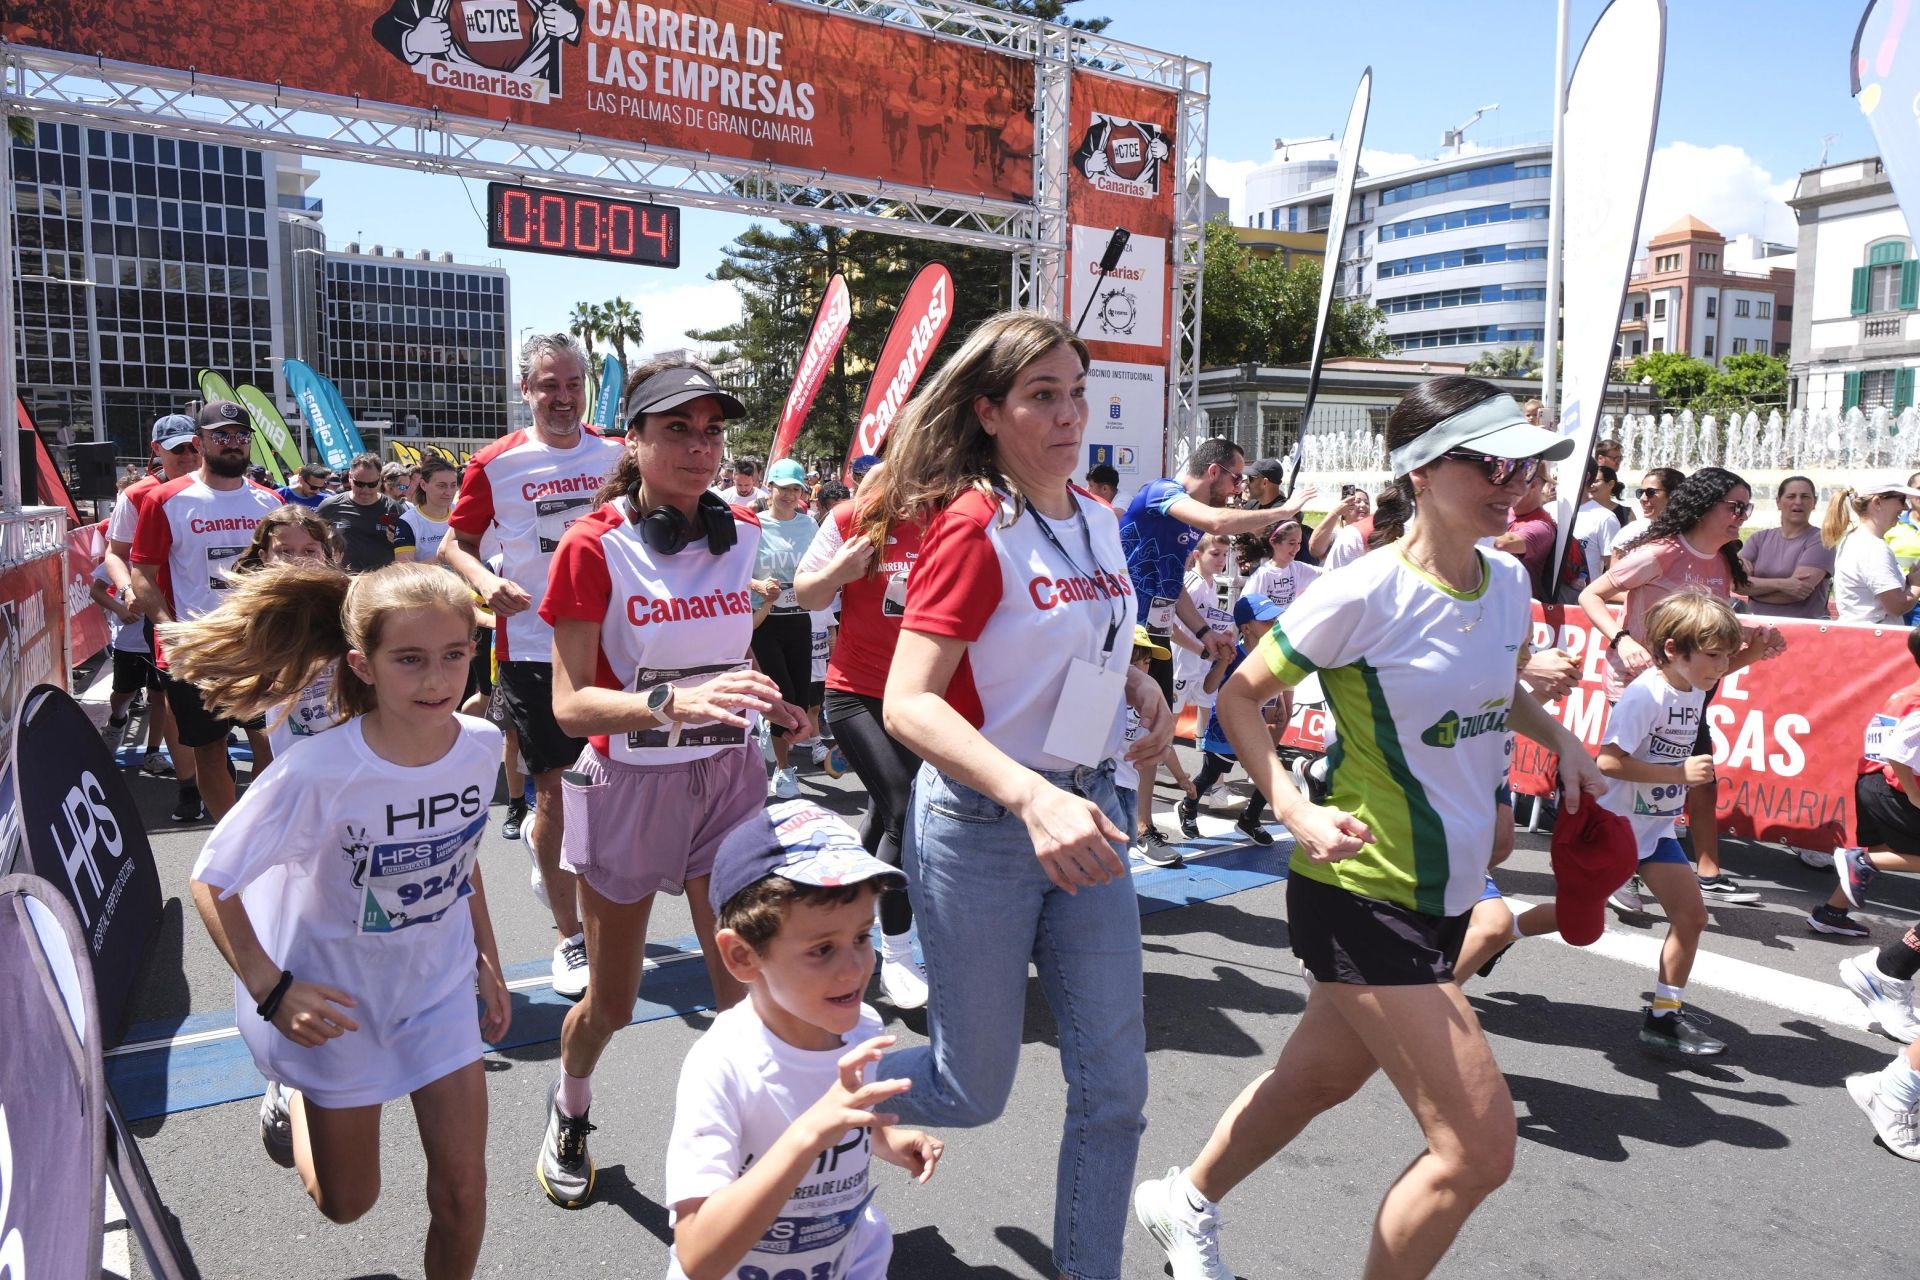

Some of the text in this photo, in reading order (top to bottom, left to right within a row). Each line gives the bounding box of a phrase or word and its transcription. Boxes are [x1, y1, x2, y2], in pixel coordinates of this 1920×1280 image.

[465, 8, 520, 34] #C7CE
[588, 0, 784, 71] CARRERA DE
[431, 62, 545, 101] Canarias7
[587, 42, 815, 121] LAS EMPRESAS
[587, 90, 814, 147] LAS PALMAS DE GRAN CANARIA
[1115, 142, 1140, 159] #C7CE
[1097, 176, 1151, 196] Canarias7
[503, 190, 667, 258] 0:00:04
[858, 274, 948, 455] Canarias7
[1112, 370, 1154, 382] INSTITUCIONAL
[626, 588, 752, 628] Canarias
[1028, 568, 1133, 611] Canarias
[1668, 706, 1699, 726] HPS
[386, 784, 480, 836] HPS
[1715, 776, 1847, 834] CANARIA
[50, 770, 124, 929] HPS
[378, 844, 432, 866] HPS
